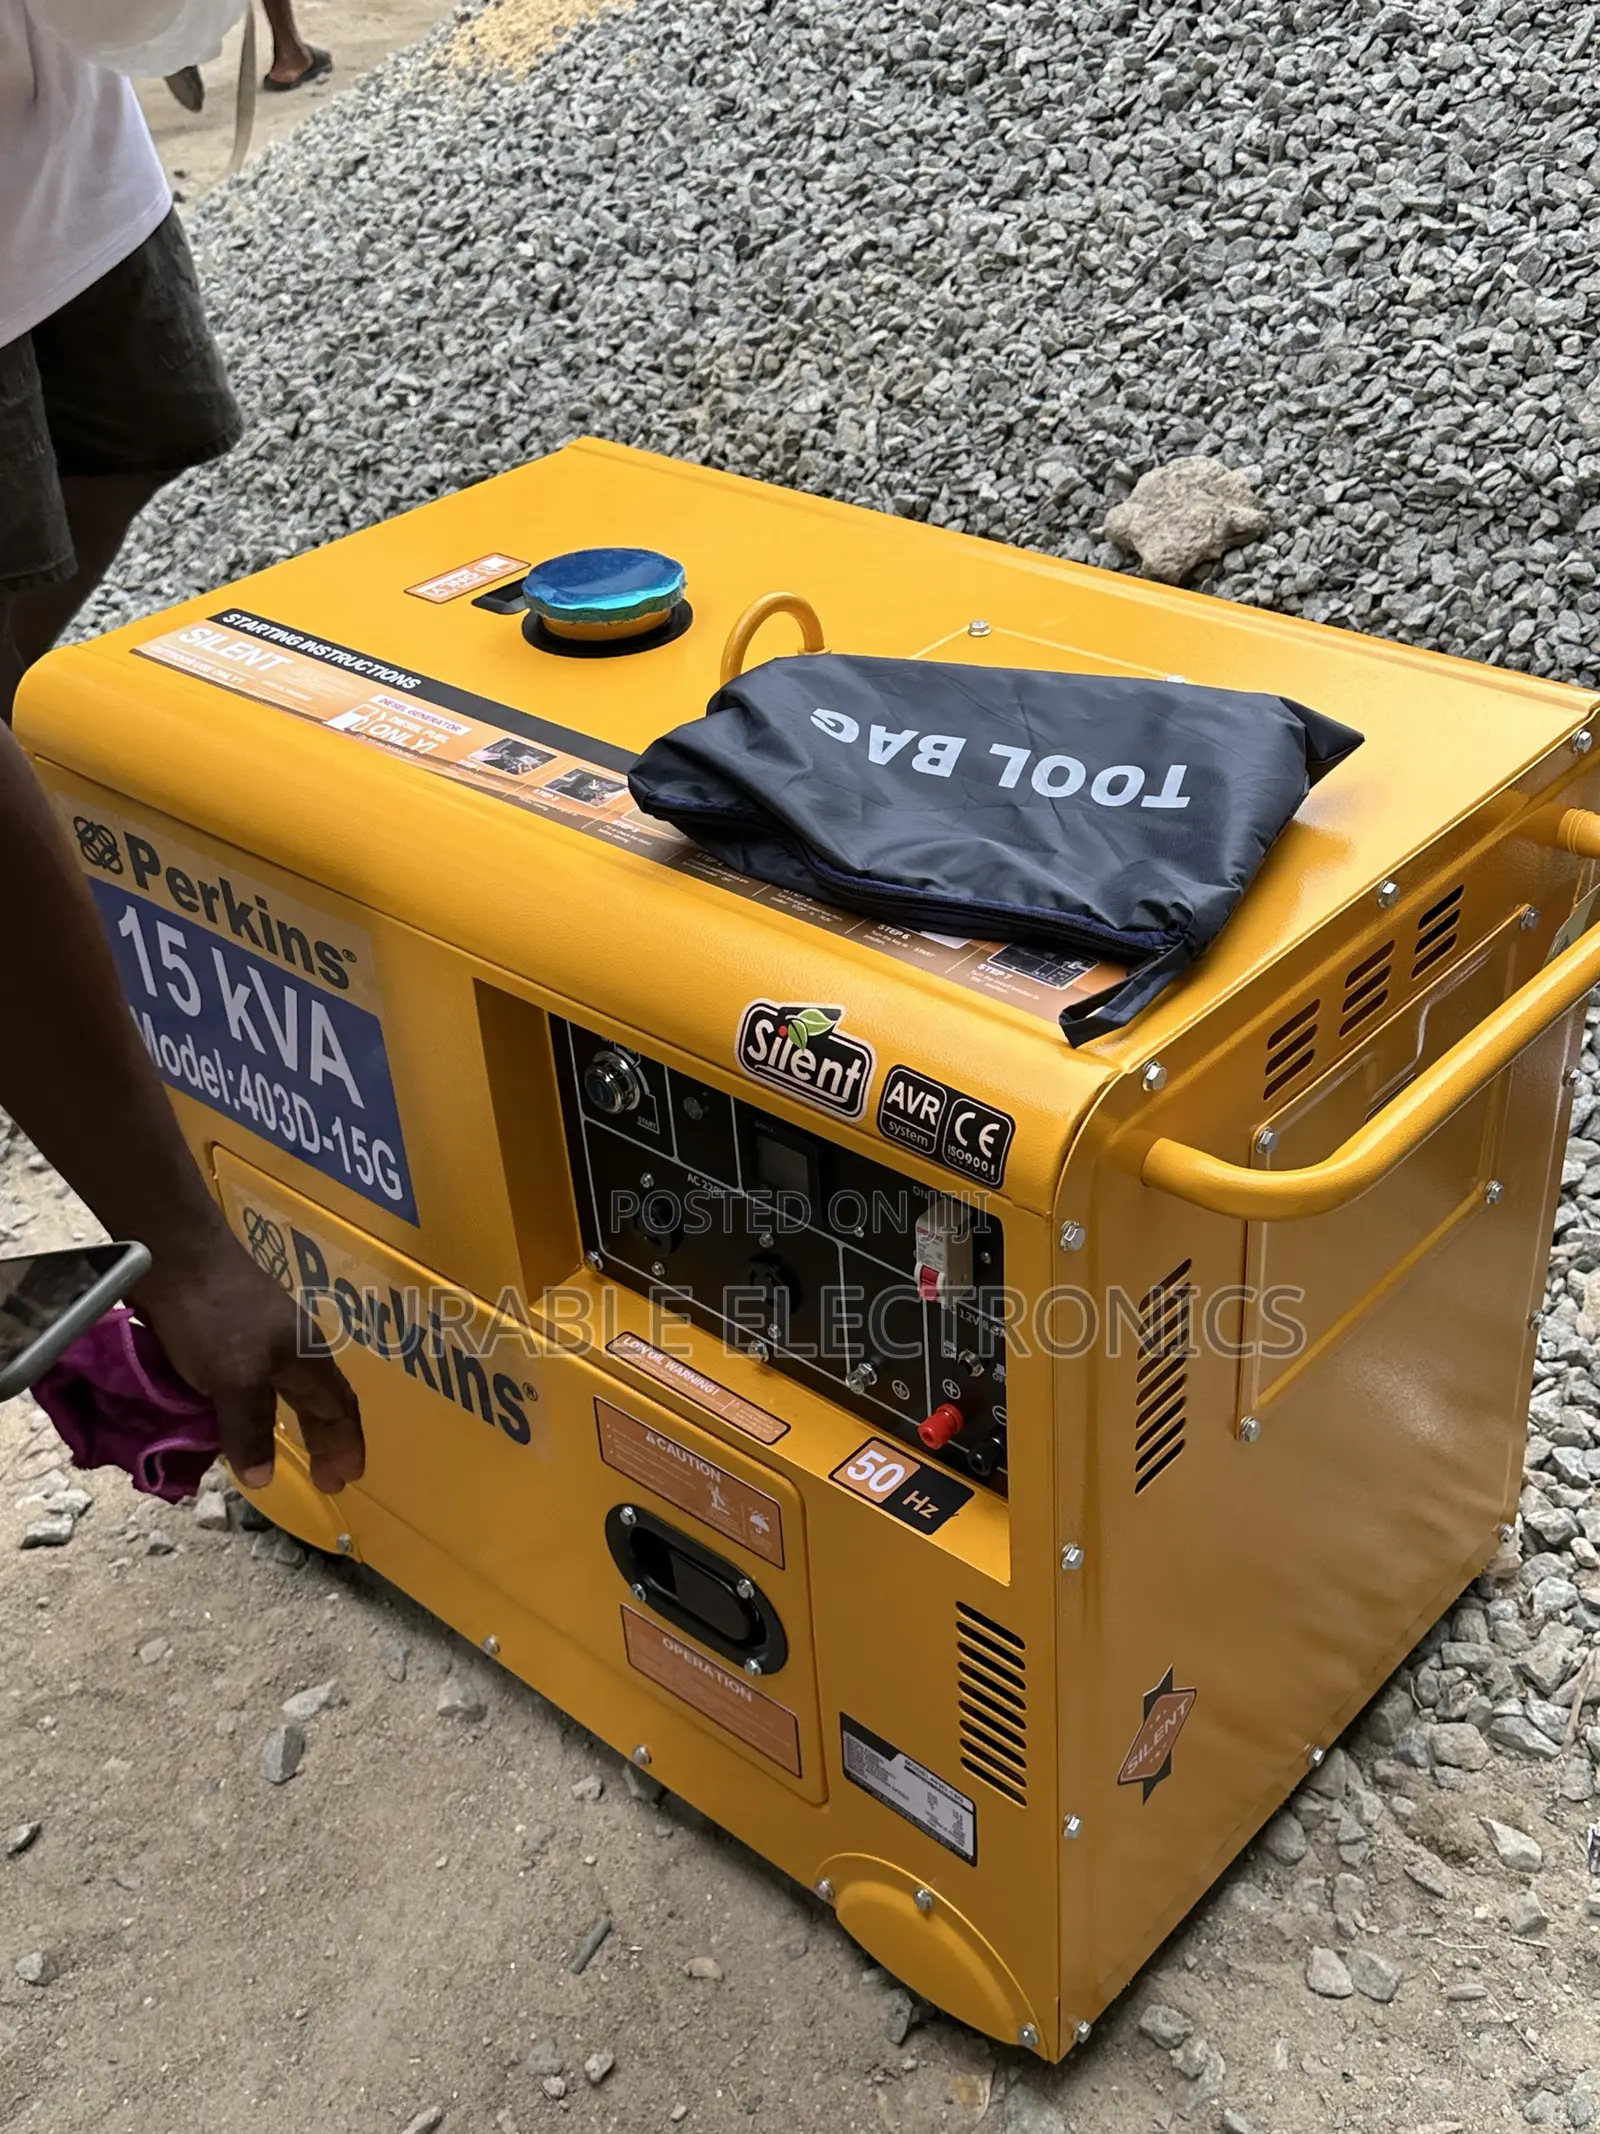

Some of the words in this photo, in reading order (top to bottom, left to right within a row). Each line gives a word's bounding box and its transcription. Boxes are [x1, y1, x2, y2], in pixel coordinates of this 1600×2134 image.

[179, 626, 293, 671] SILENT
[222, 613, 303, 649] STARTING
[297, 638, 422, 690] INSTRUCTIONS
[809, 707, 967, 778] BAG
[988, 742, 1191, 809] TOOL
[122, 831, 350, 990] Perkins
[877, 923, 904, 936] STEP
[977, 963, 1006, 977] STEP
[118, 904, 201, 1018] 15
[212, 946, 366, 1109] kVA
[746, 1017, 862, 1101] Silent
[886, 1080, 941, 1127] AVR
[888, 1119, 929, 1148] system
[947, 1144, 997, 1176] ISO9001
[953, 1111, 1000, 1159] CE
[687, 1172, 702, 1187] AC
[289, 1226, 533, 1447] Perkins
[646, 1348, 665, 1367] OIL
[664, 1358, 721, 1396] WARNING!
[656, 1437, 722, 1484] CAUTION
[846, 1448, 906, 1492] 50
[902, 1487, 939, 1519] Hz
[661, 1636, 753, 1703] OPERATION
[1126, 1697, 1189, 1776] SILENT
